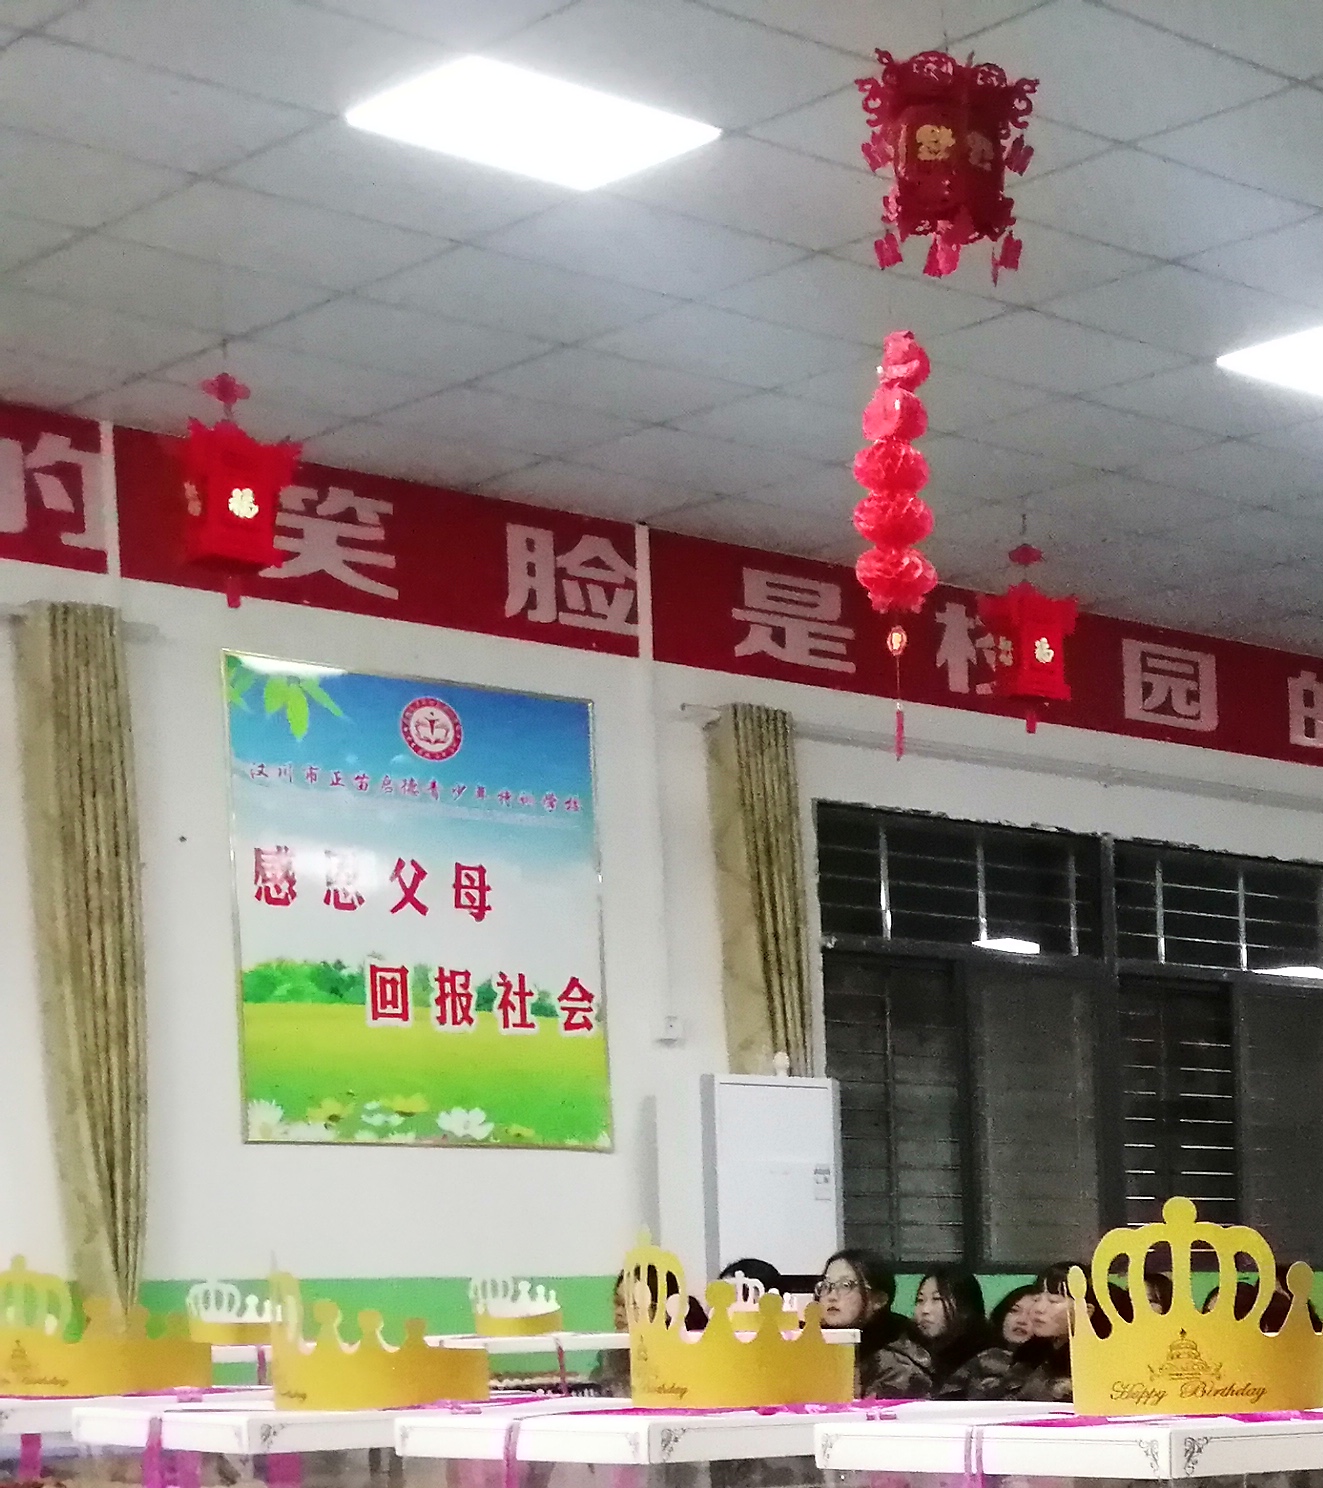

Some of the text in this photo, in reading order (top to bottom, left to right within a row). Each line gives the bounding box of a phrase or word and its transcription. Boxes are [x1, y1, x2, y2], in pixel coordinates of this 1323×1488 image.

[369, 964, 595, 1032] 回报社会
[1180, 1379, 1267, 1405] Birthday
